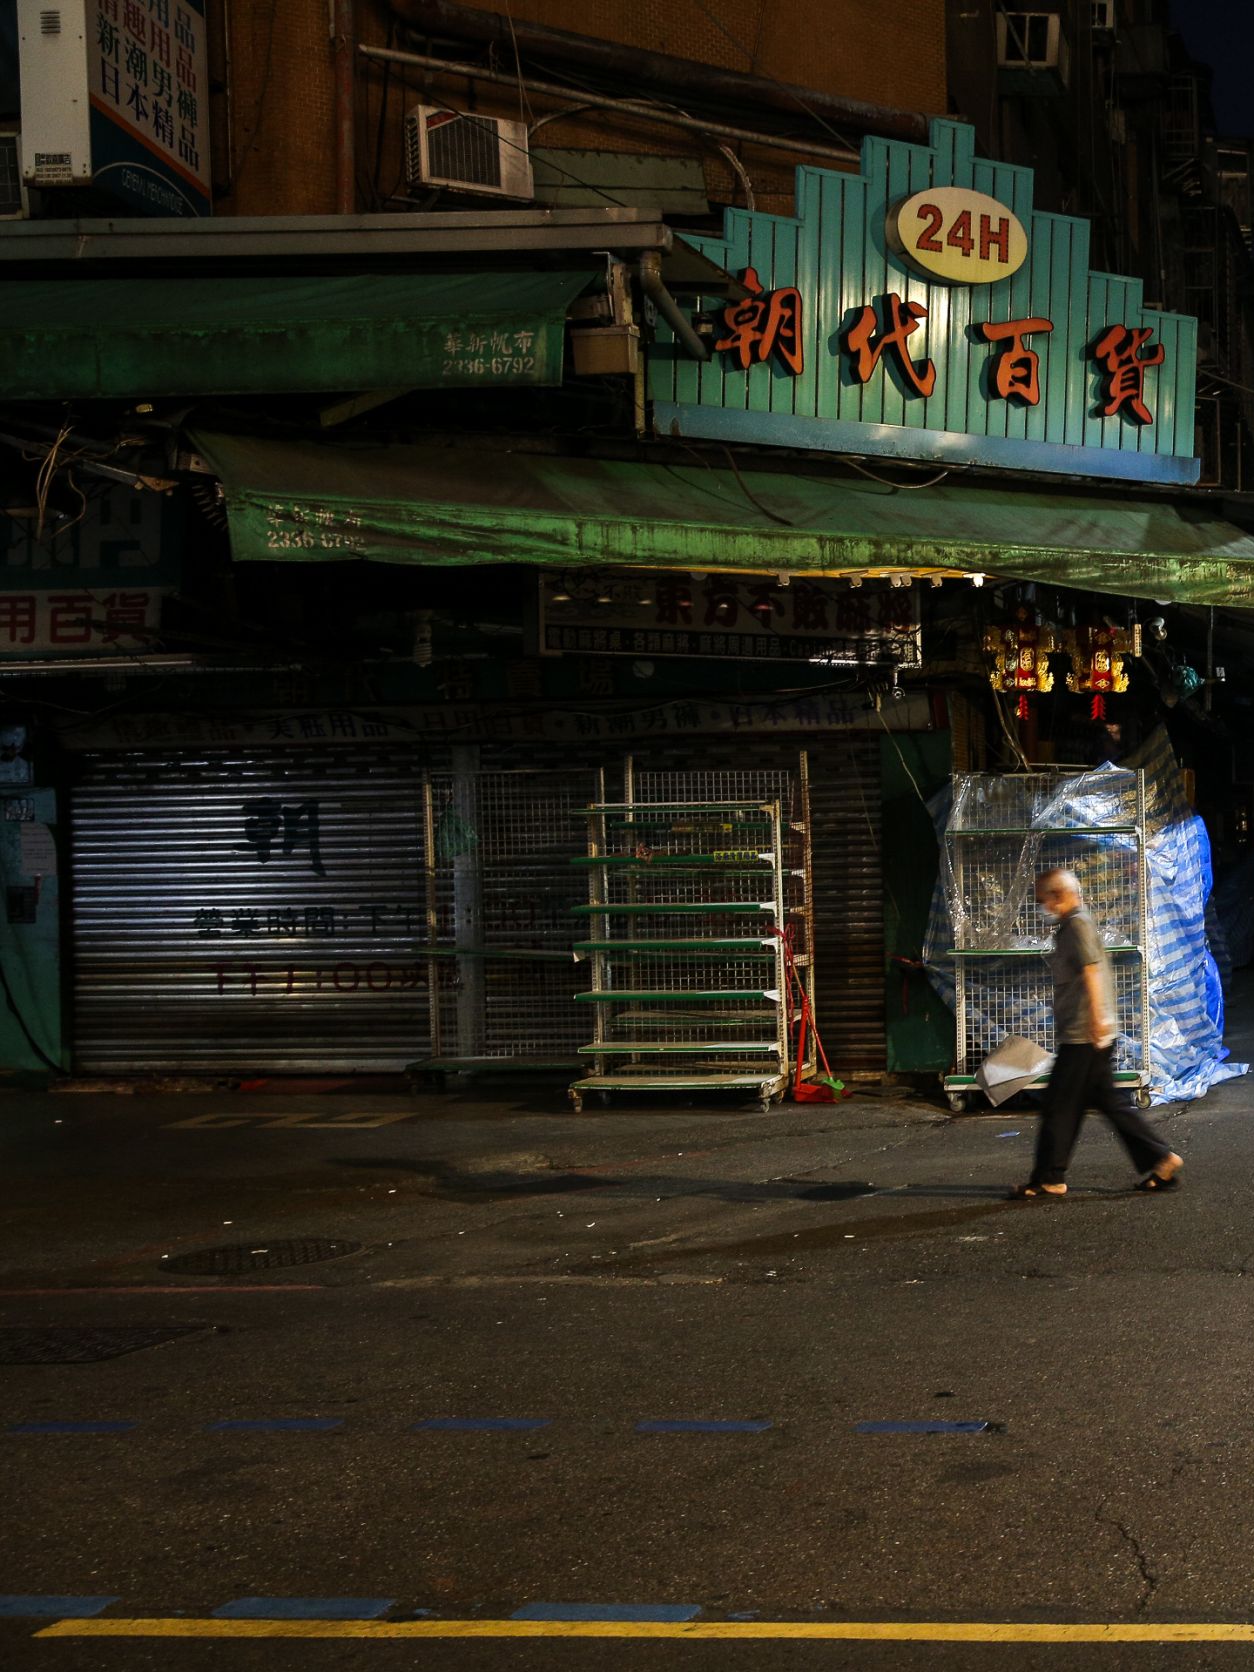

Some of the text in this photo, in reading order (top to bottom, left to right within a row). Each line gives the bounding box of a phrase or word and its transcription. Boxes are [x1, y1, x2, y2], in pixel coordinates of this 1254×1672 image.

[98, 14, 198, 128] 新潮男褲
[101, 58, 199, 171] 日本精品
[916, 203, 1010, 264] 24H
[441, 357, 536, 376] 2336-6792
[714, 267, 1166, 425] 朝代百貨
